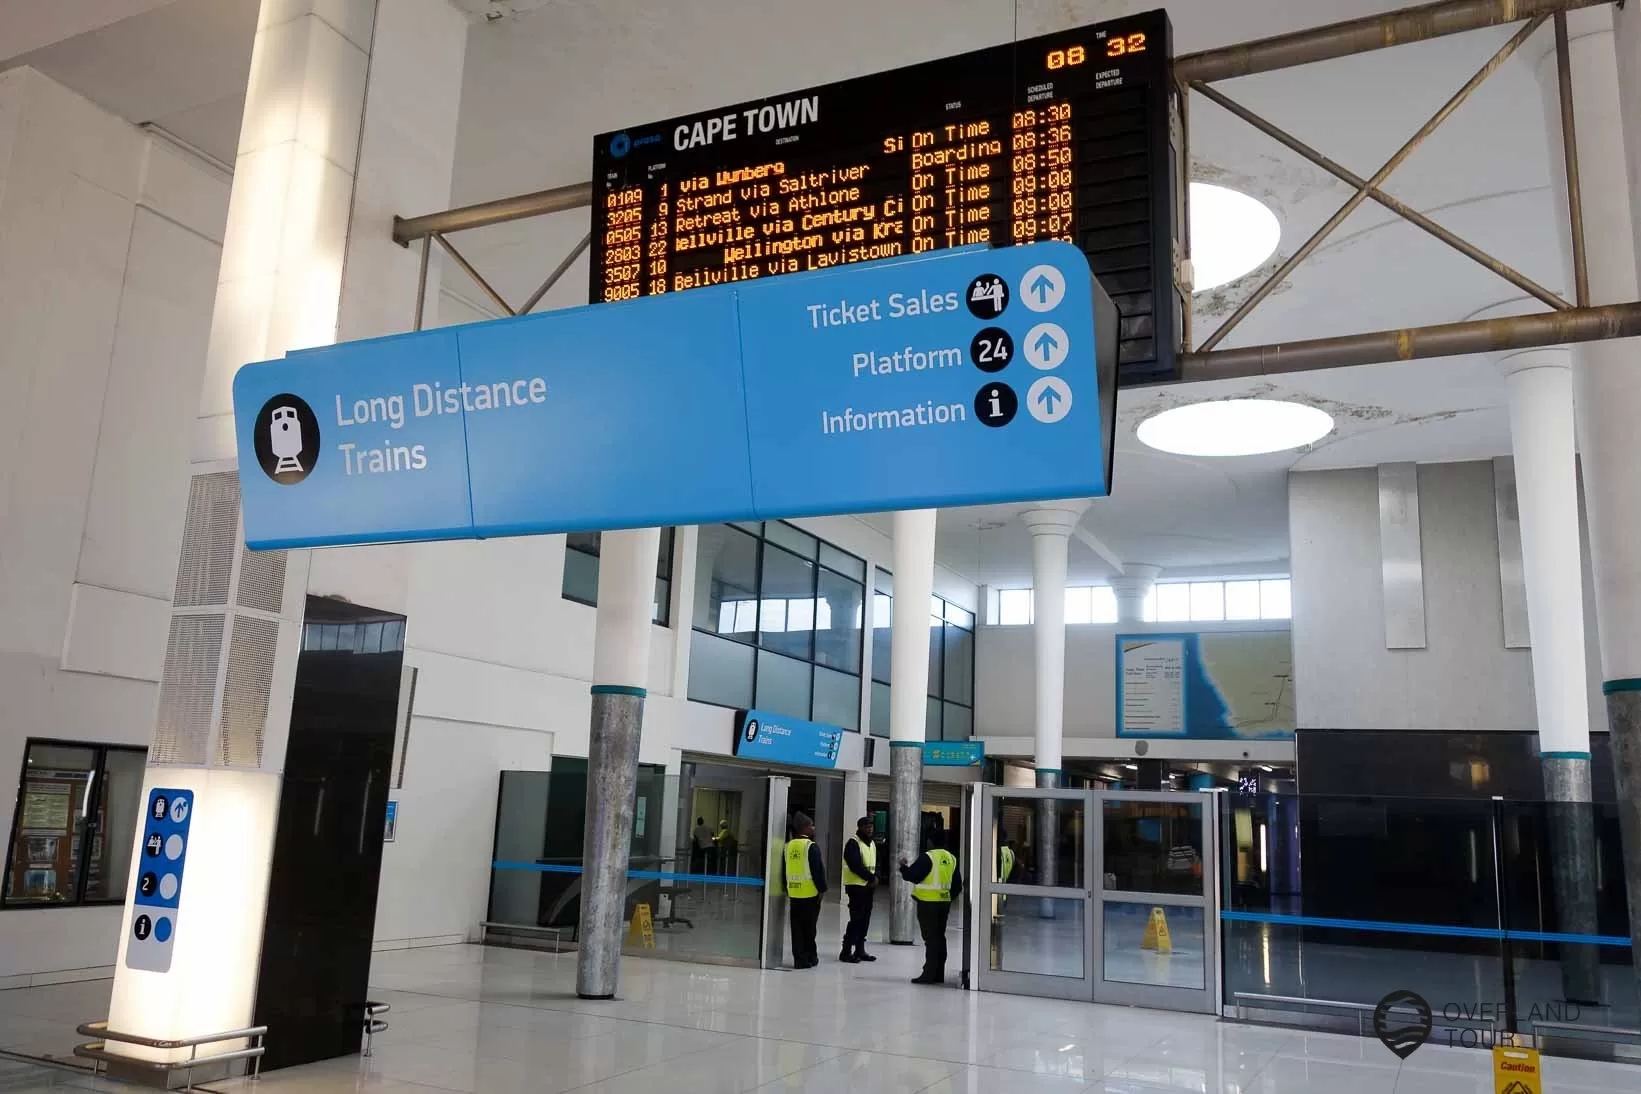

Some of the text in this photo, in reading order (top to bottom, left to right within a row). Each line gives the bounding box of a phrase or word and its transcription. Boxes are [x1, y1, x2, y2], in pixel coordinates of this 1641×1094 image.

[1047, 33, 1146, 69] 08 32
[1027, 82, 1054, 94] SCHEDULED
[1095, 68, 1120, 80] EXPECTED
[1095, 77, 1123, 89] DEPARTURE
[945, 101, 962, 111] STATUS
[1027, 91, 1054, 103] DEPARTURE
[673, 95, 819, 151] CAPE TOWN
[775, 135, 800, 145] DESTINATION
[607, 189, 642, 208] 0109
[680, 177, 709, 192] via
[883, 136, 904, 154] Si
[912, 132, 934, 149] On
[945, 121, 990, 142] Time
[1013, 103, 1071, 129] 08:30
[607, 125, 1071, 226] 3205 9 Strand via Saltriver Boarding 08:36
[606, 147, 1071, 245] 0505 13 Retreat via Athlone On Time 08:50
[605, 245, 641, 264] 2803
[649, 240, 667, 257] 22
[762, 219, 794, 236] via
[802, 205, 875, 230] Century
[884, 198, 903, 216] Ci
[912, 194, 934, 211] On
[945, 184, 990, 206] Time
[1013, 169, 1072, 194] 09:00
[605, 264, 640, 283] 3507
[649, 259, 667, 276] 10
[724, 234, 823, 263] Wellington
[832, 227, 865, 244] via
[912, 215, 934, 233] On
[945, 206, 990, 227] Time
[1013, 191, 1072, 216] 09:00
[604, 283, 640, 302] 9005
[649, 278, 666, 295] 18
[675, 265, 759, 291] Bellville
[768, 255, 798, 274] via
[808, 242, 902, 271] Lavistown
[912, 237, 934, 254] On
[945, 227, 990, 249] Time
[1013, 212, 1072, 238] 09:07
[807, 289, 959, 329] Ticket Sales
[852, 337, 1008, 377] Platform 24
[336, 376, 548, 430] Long Distance
[822, 399, 966, 434] Information
[337, 440, 428, 477] Trains
[760, 722, 773, 734] Long
[1501, 1061, 1536, 1073] Caution
